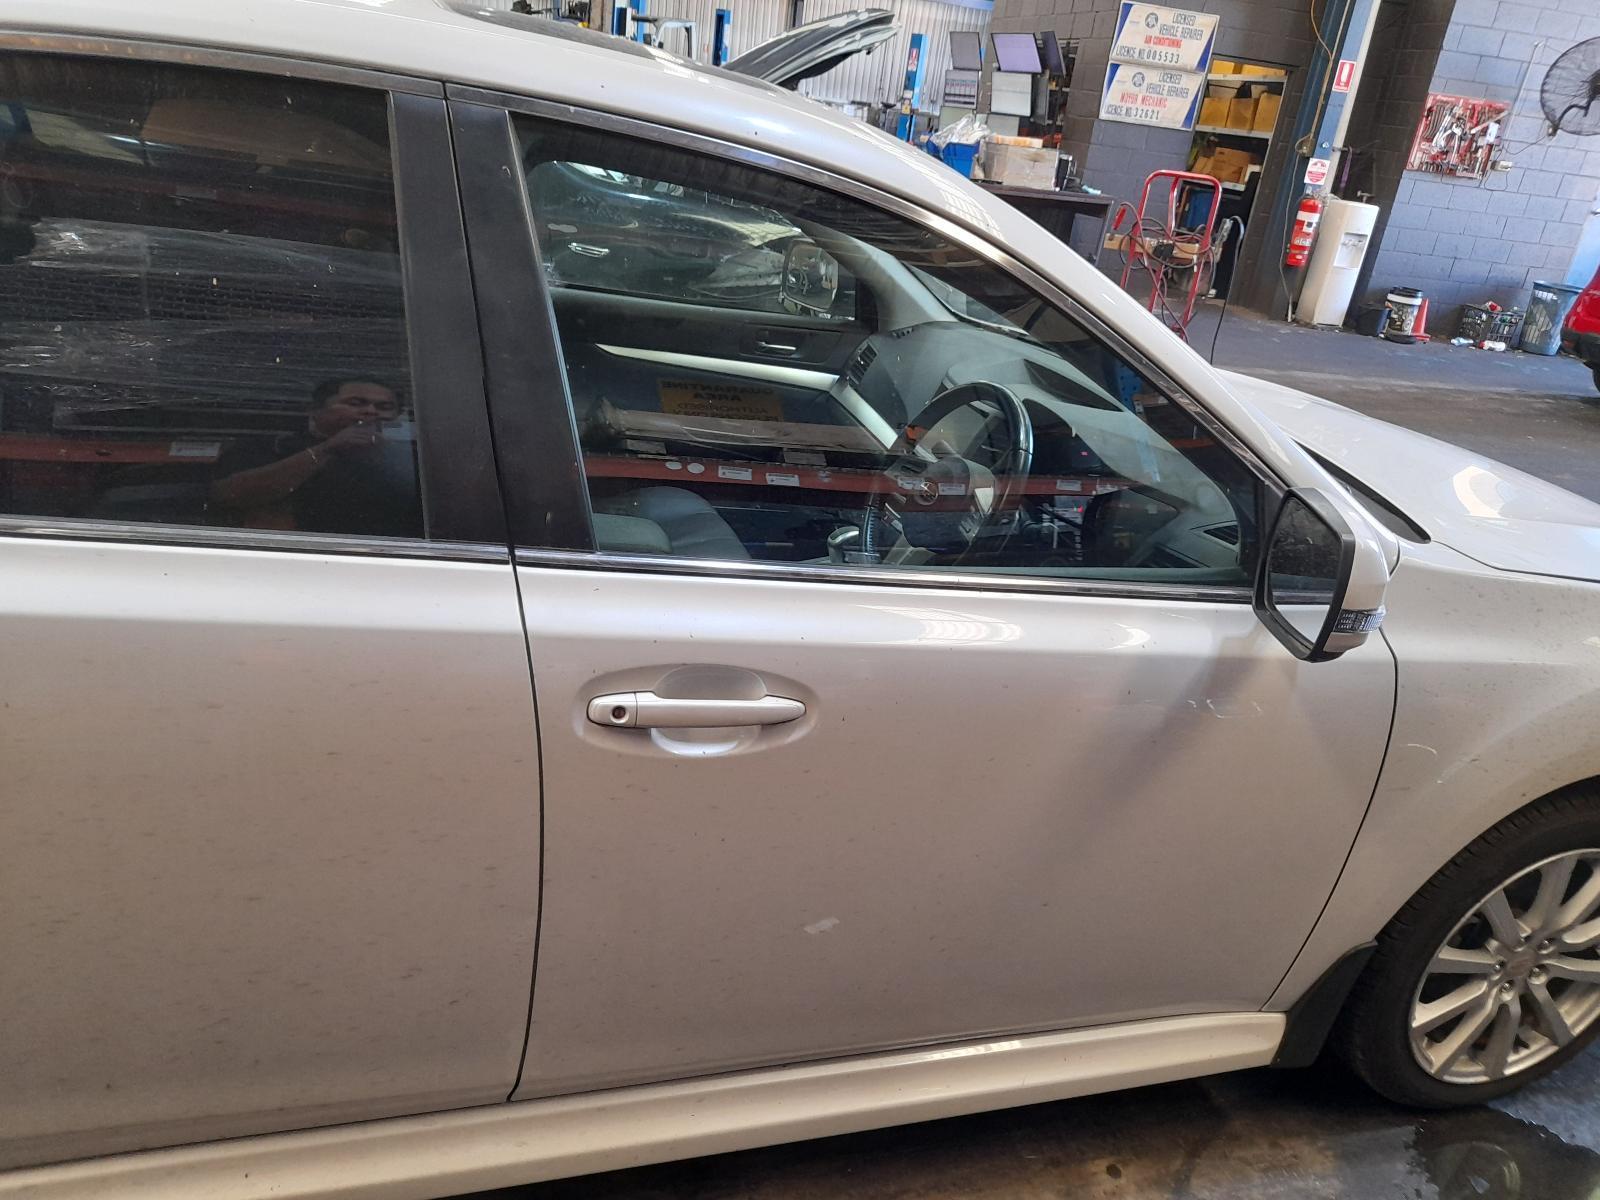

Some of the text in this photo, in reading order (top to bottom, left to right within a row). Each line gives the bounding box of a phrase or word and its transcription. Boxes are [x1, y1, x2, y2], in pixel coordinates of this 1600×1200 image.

[1160, 24, 1203, 40] VEHICLE REPAIRER
[1146, 83, 1190, 99] VEHICLE REPAIRER
[1120, 92, 1168, 108] MOTOR MECHANIC
